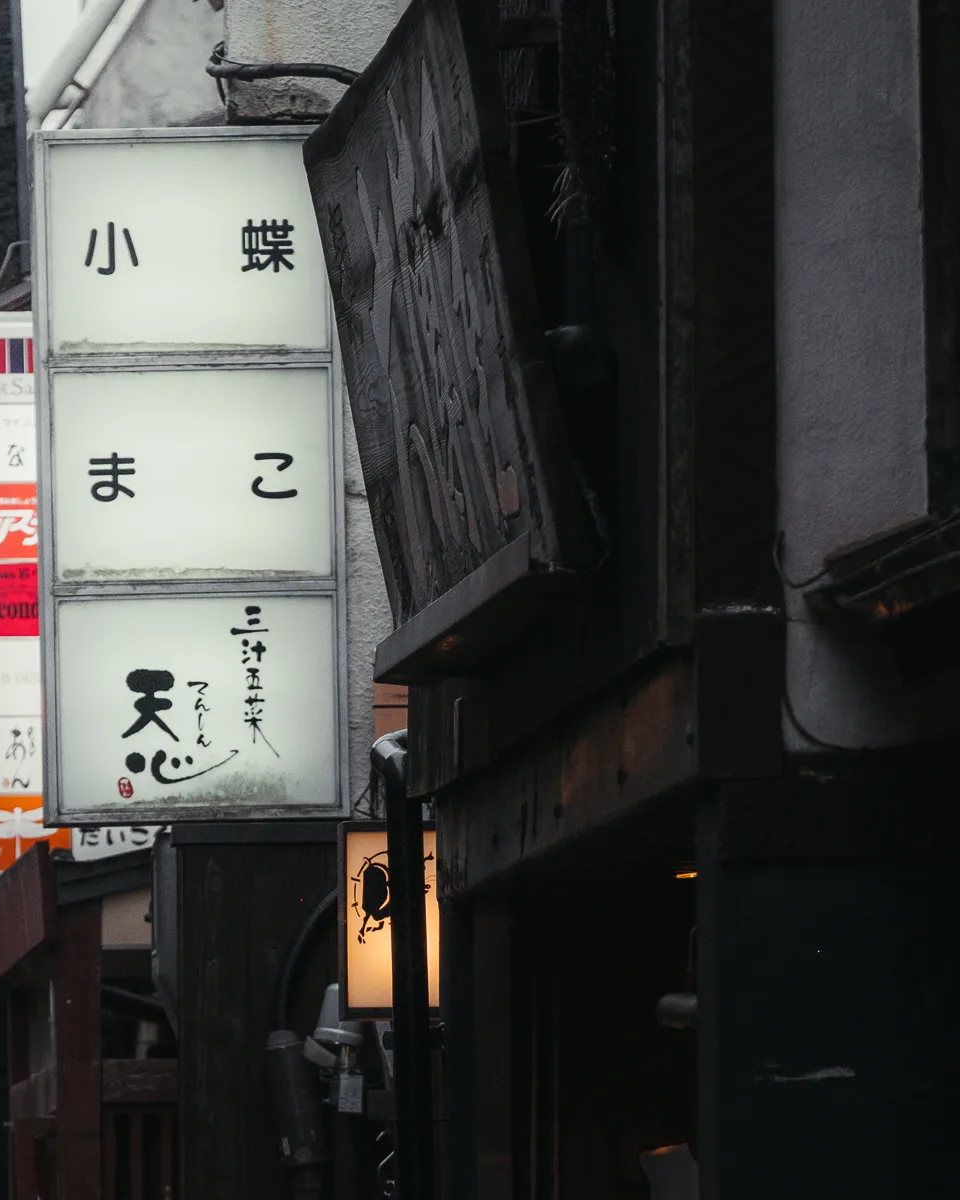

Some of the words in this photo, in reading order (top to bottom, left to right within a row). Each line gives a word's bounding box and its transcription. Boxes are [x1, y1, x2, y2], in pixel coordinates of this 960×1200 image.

[121, 668, 240, 785] 天心
[186, 681, 212, 748] てんしん
[230, 606, 280, 758] 三汁五菜
